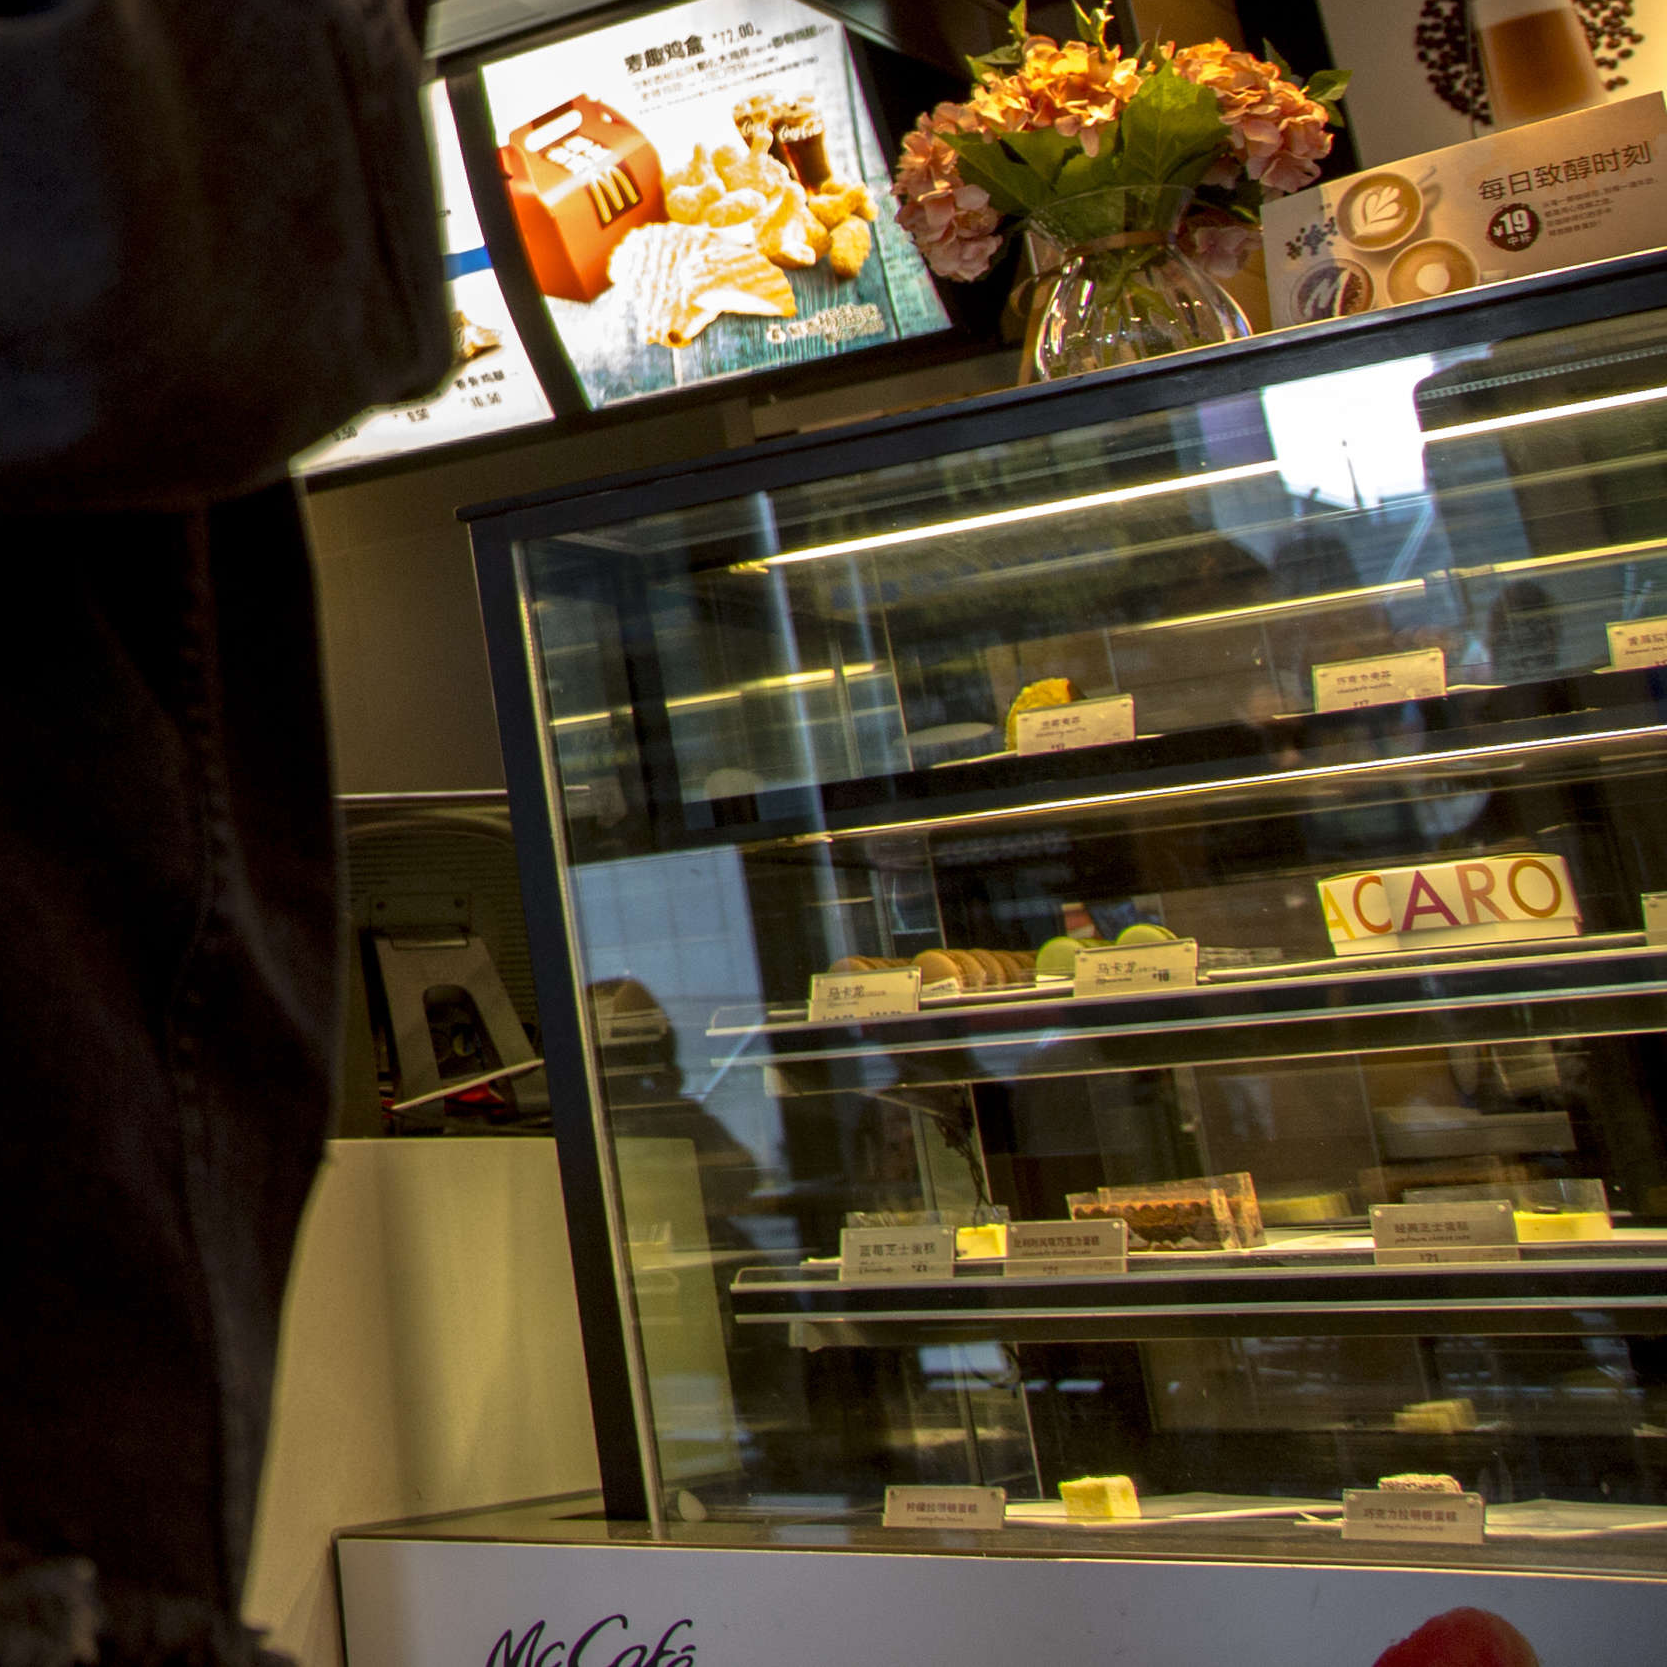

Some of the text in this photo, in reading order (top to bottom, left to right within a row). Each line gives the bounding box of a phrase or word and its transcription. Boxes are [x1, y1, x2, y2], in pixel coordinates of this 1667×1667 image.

[1479, 140, 1652, 201] 每日致醇时刻
